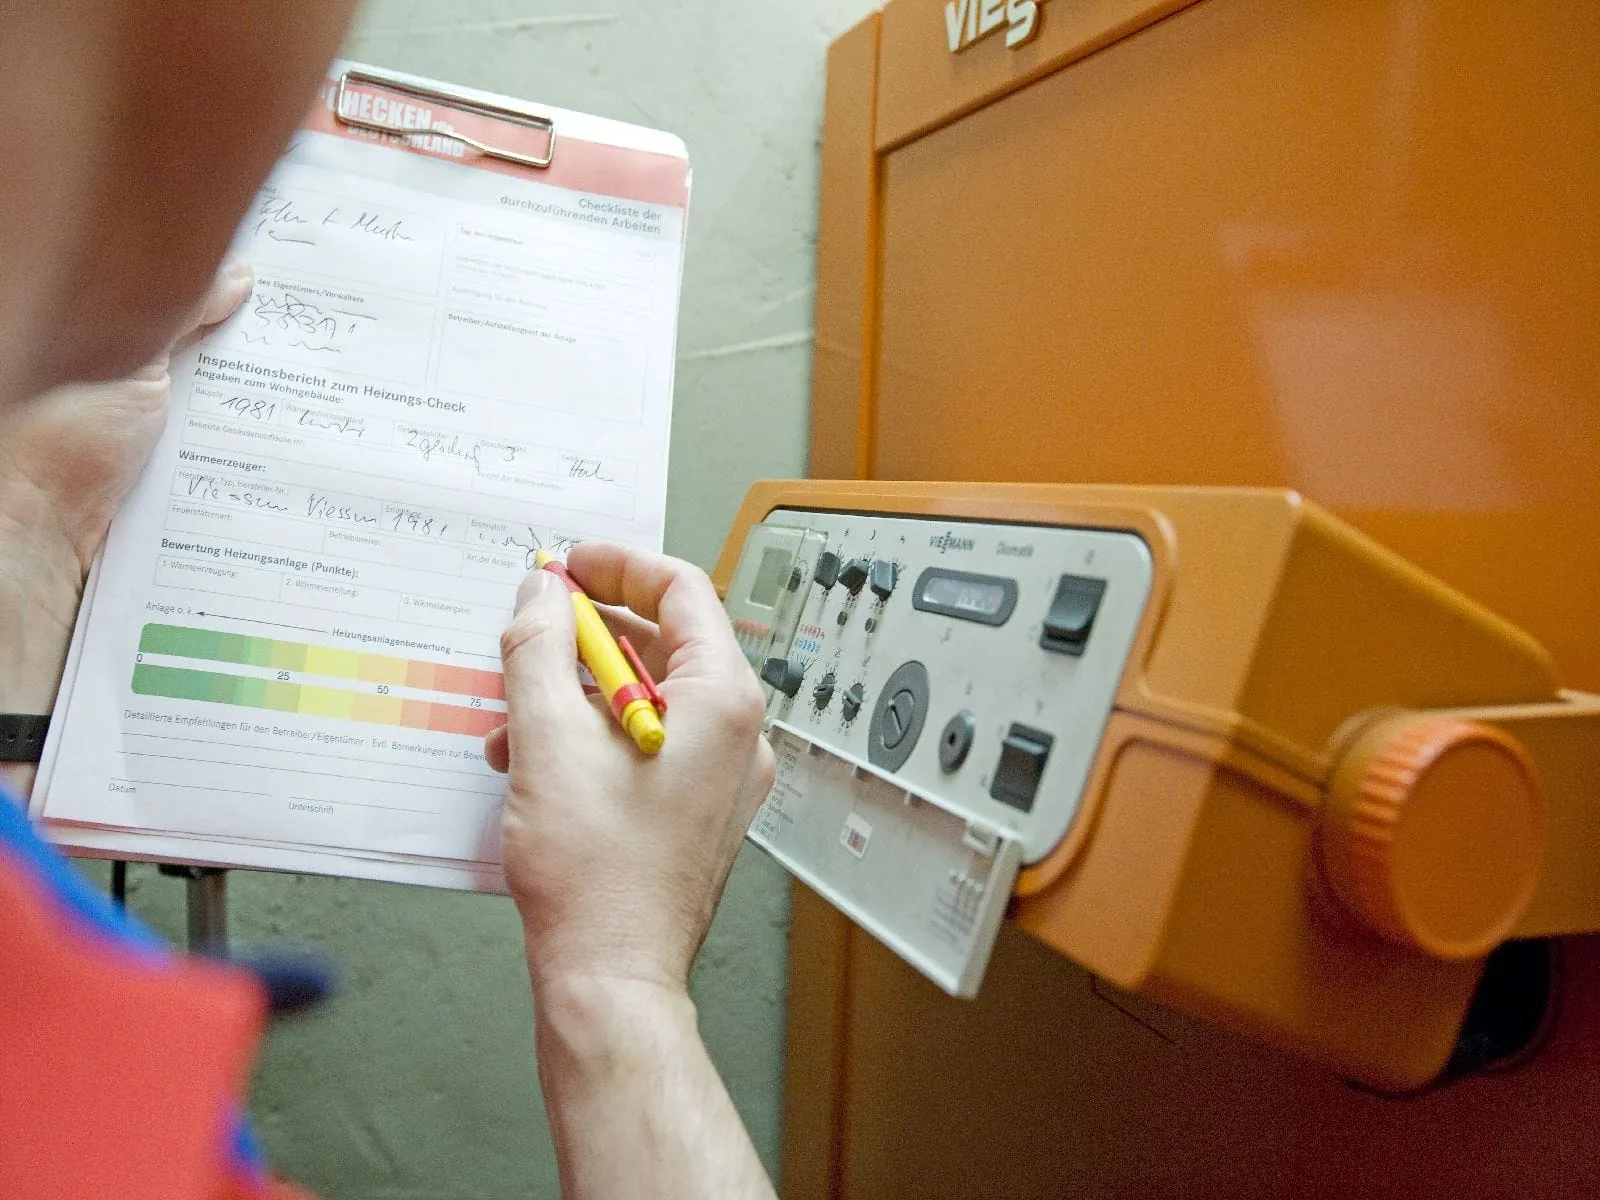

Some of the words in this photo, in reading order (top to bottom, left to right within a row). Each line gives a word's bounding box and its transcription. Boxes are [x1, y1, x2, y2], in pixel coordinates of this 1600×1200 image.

[500, 195, 608, 225] durchzuführenden
[611, 217, 661, 235] Arbeiten
[579, 198, 639, 218] Checkliste
[643, 208, 662, 221] der
[194, 367, 241, 386] Angaben
[244, 378, 266, 390] zum
[269, 381, 344, 404] Wohngebäude:
[198, 352, 327, 388] Inspektionsbericht
[331, 382, 359, 394] zum
[363, 384, 467, 414] Heizungs-Check
[220, 395, 276, 421] 1981
[179, 449, 266, 473] Wärmeerzeuger:
[161, 538, 221, 558] Bewertung
[224, 547, 308, 571] Heizungsanlage
[311, 561, 359, 580] (Punkte):
[145, 601, 176, 615] Anlage
[332, 627, 451, 655] Heizungsanlagenbewertung
[136, 653, 143, 664] 0
[277, 671, 290, 681] 25
[377, 685, 389, 695] 50
[470, 698, 482, 708] 75
[124, 709, 173, 724] Detaillierte
[175, 714, 237, 731] Empfehlungen
[239, 719, 252, 732] für
[253, 724, 270, 735] den
[272, 726, 364, 746] Betreiber/Eigentümer
[372, 738, 389, 750] Evtl.
[391, 741, 447, 758] Bemerkungen
[108, 782, 136, 794] Datum
[288, 801, 335, 815] Unterschrift
